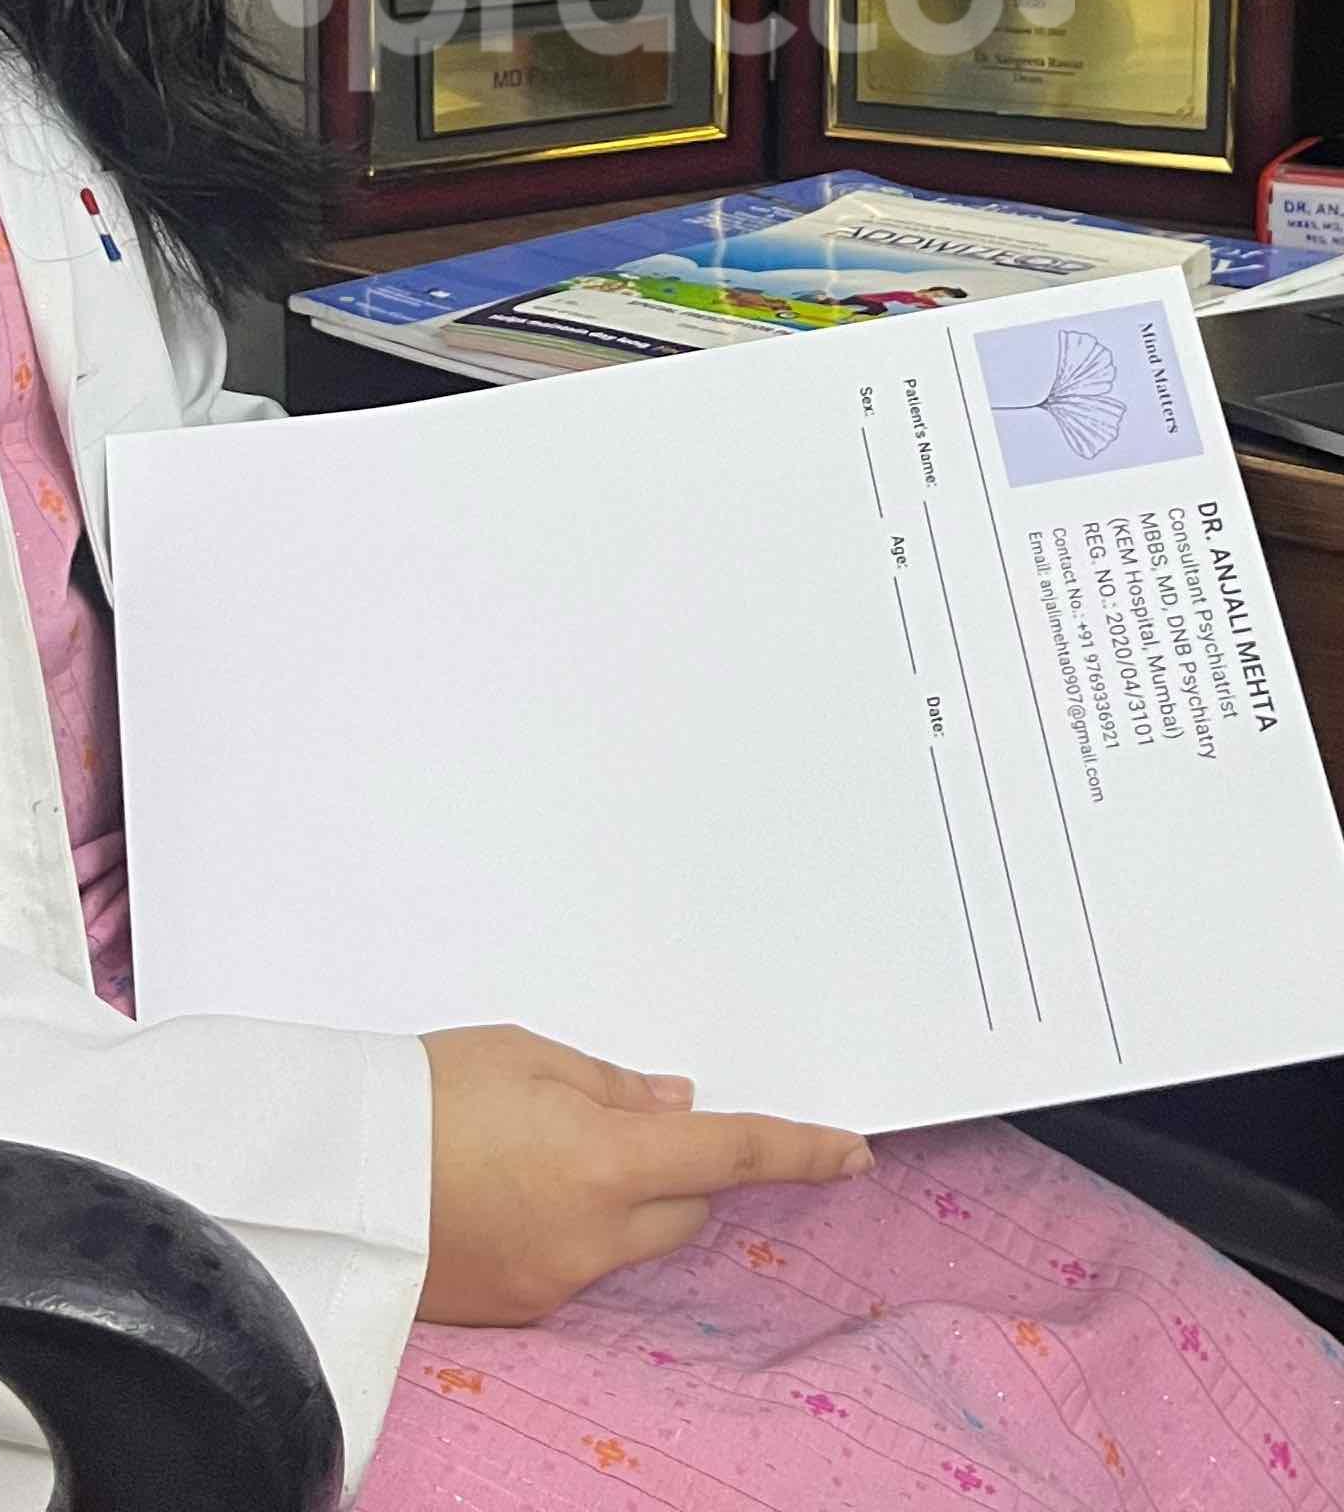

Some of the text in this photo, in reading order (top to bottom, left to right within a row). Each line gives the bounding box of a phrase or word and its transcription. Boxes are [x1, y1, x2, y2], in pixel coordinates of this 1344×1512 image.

[493, 70, 522, 89] MD
[1284, 199, 1311, 216] DR.
[903, 378, 939, 489] Patient's Name:
[1138, 320, 1180, 435] Mind Matters
[859, 385, 945, 738] Sex: Age: Date:
[1029, 531, 1104, 804] Email: anjalimehta0907@gmail.com
[1053, 527, 1077, 586] Contact
[1076, 622, 1094, 649] +91
[1086, 653, 1120, 750] 9769336921
[1082, 521, 1106, 565] REG.
[1105, 611, 1155, 746] 2020/04/3101
[1107, 517, 1184, 740] (KEM Hospital, Mumbai)
[1140, 512, 1217, 761] MBBS, MD, DNB Psychiatry
[1167, 507, 1239, 719] Consultant Psychiatrist
[1198, 501, 1278, 733] DR. ANJALI MEHTA
